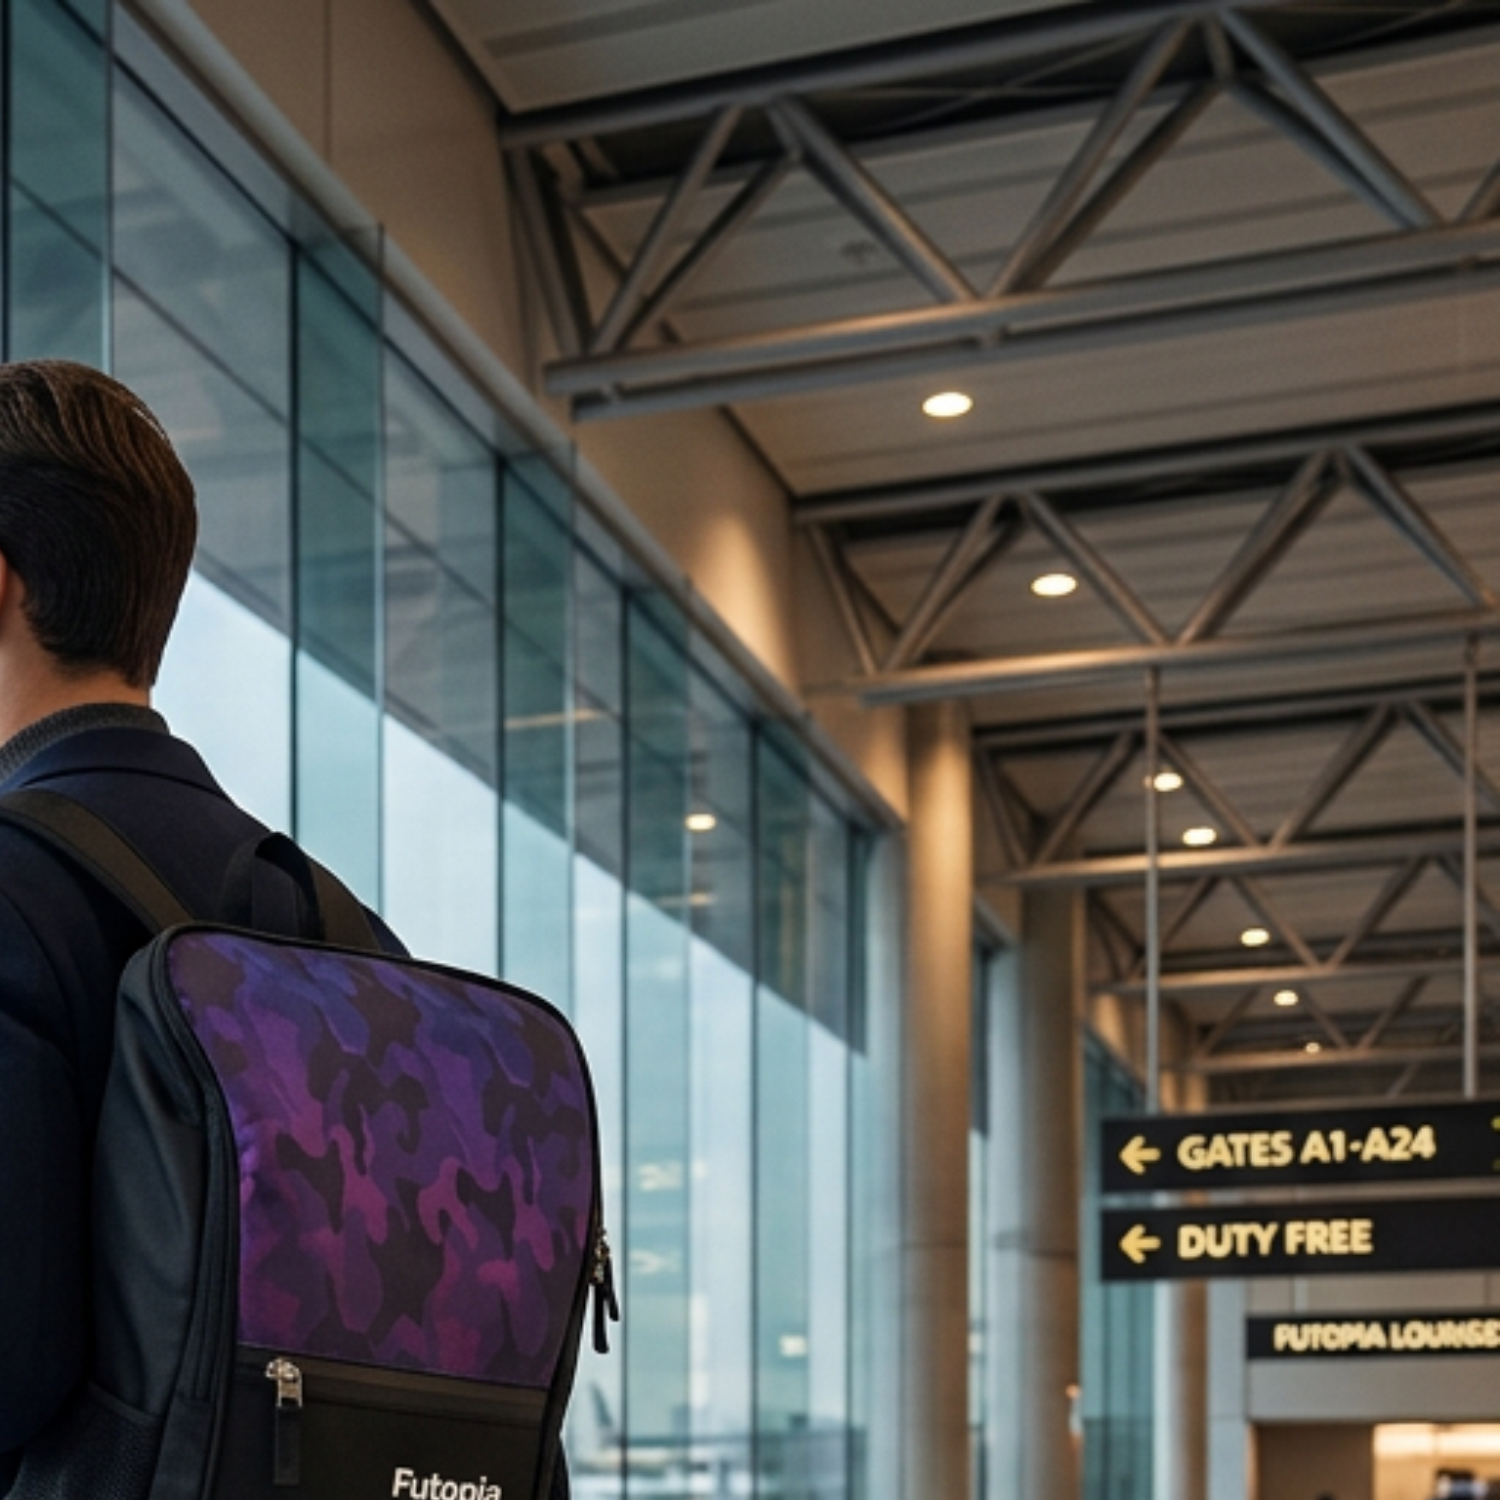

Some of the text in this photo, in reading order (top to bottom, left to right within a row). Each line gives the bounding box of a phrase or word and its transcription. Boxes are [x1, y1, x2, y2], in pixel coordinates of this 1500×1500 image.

[1177, 1125, 1437, 1170] GATES A1-A24
[1177, 1219, 1374, 1259] DUTY FREE
